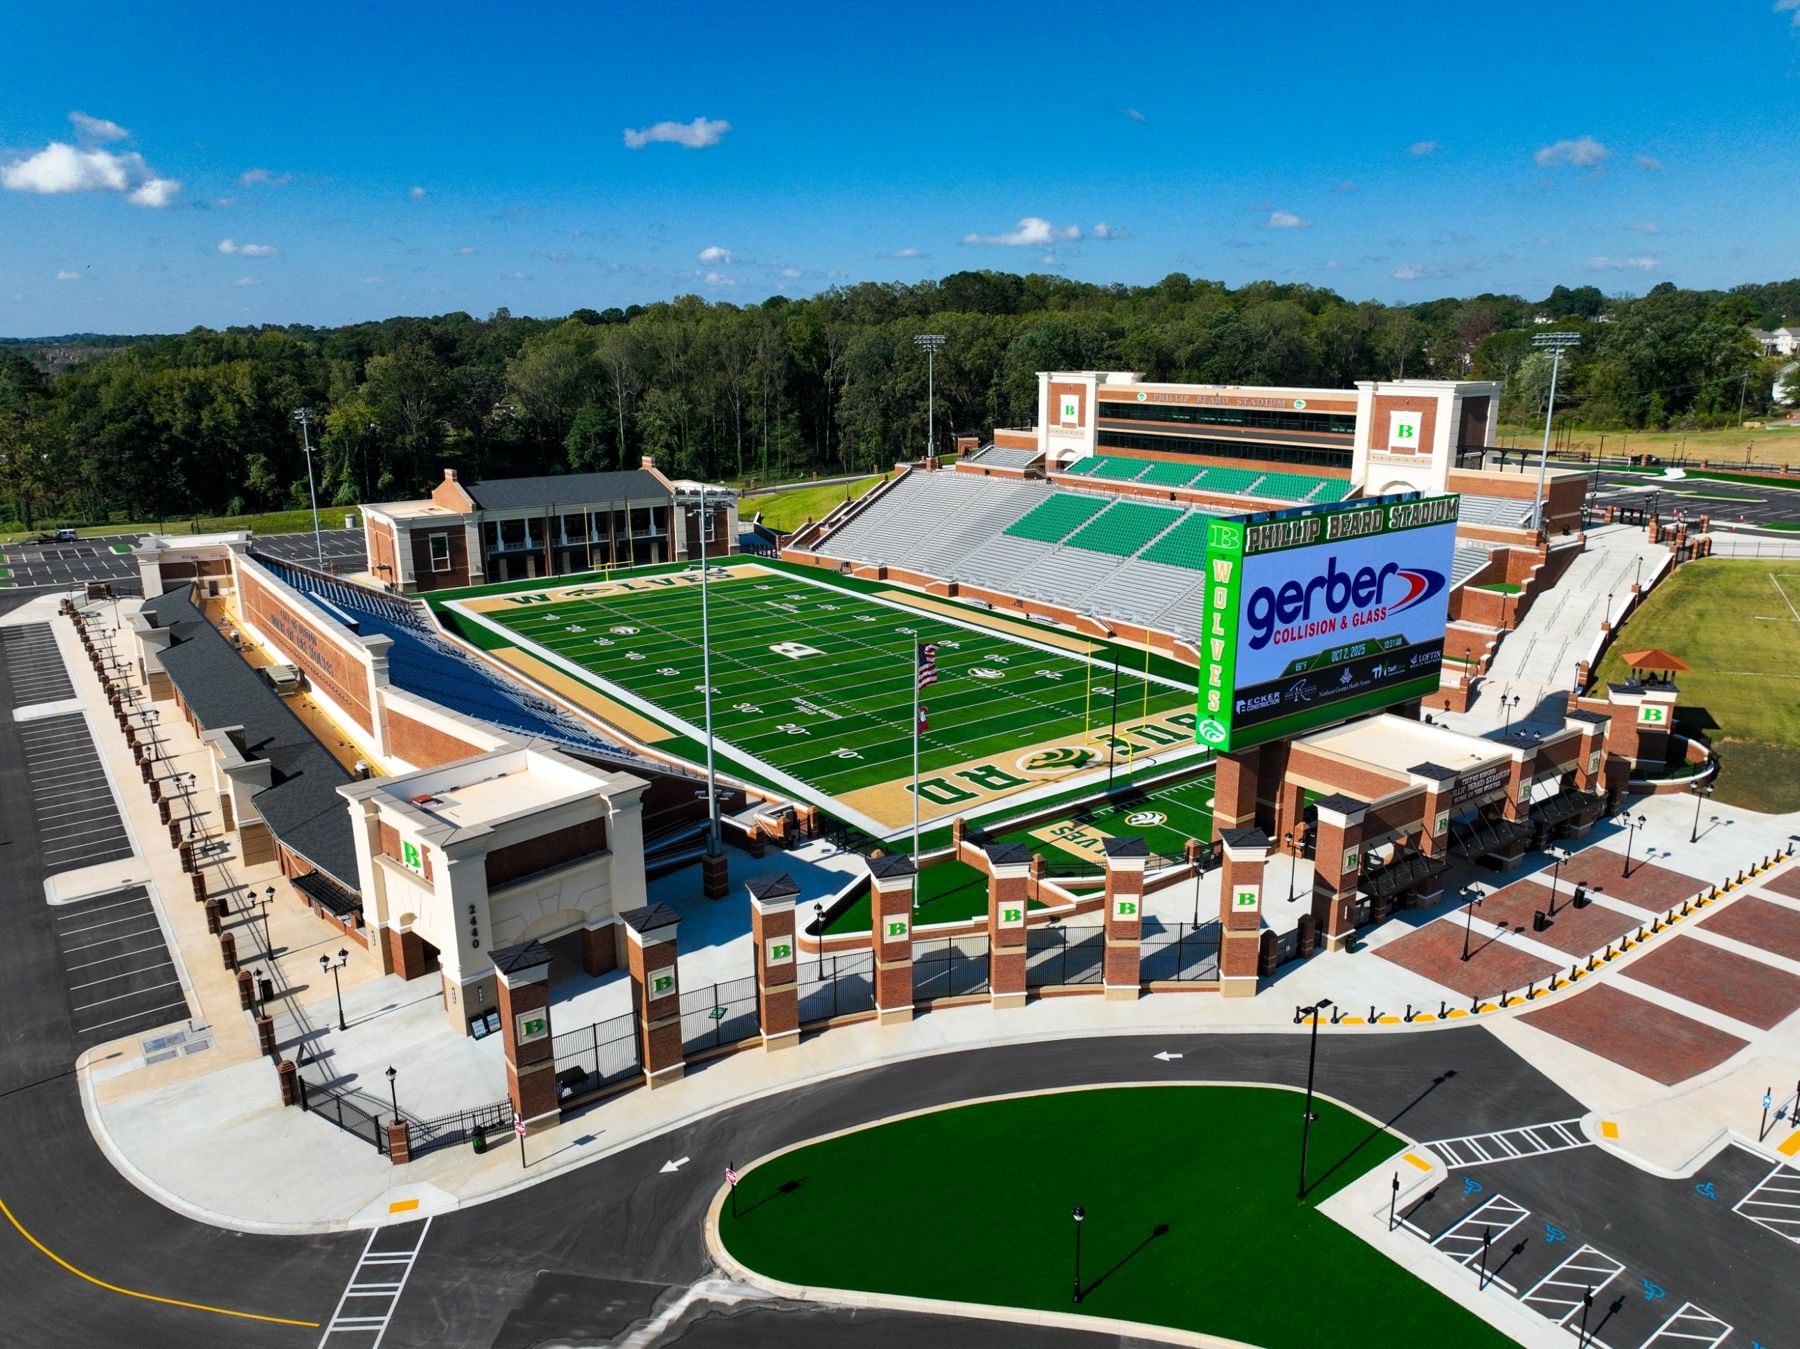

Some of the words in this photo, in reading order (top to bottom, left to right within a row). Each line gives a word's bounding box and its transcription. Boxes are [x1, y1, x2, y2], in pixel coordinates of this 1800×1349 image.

[1065, 404, 1075, 416] B
[1398, 424, 1413, 439] B
[1245, 518, 1321, 552] PHILLIP
[1327, 509, 1384, 540] BEARD
[1389, 498, 1459, 529] STADIUM
[1210, 525, 1240, 549] B
[1247, 556, 1399, 650] gerber
[1273, 618, 1336, 645] COLLISION
[1340, 616, 1348, 630] &
[1352, 606, 1387, 627] GLASS
[1207, 559, 1233, 713] WOLVES
[1331, 650, 1343, 662] OCT
[1350, 643, 1366, 657] 2025
[1418, 649, 1442, 662] LOFTIN
[1247, 691, 1280, 705] ECKER
[1642, 708, 1663, 721] B
[776, 723, 807, 735] 20
[829, 747, 859, 759] 10
[1436, 816, 1448, 831] B
[402, 840, 422, 868] B
[1346, 853, 1357, 867] B
[1236, 892, 1257, 906] B
[1003, 908, 1022, 923] B
[1117, 902, 1137, 916] B
[469, 904, 480, 949] 2440
[887, 922, 907, 937] B
[771, 944, 792, 960] B
[652, 976, 673, 993] B
[521, 1018, 544, 1037] B
